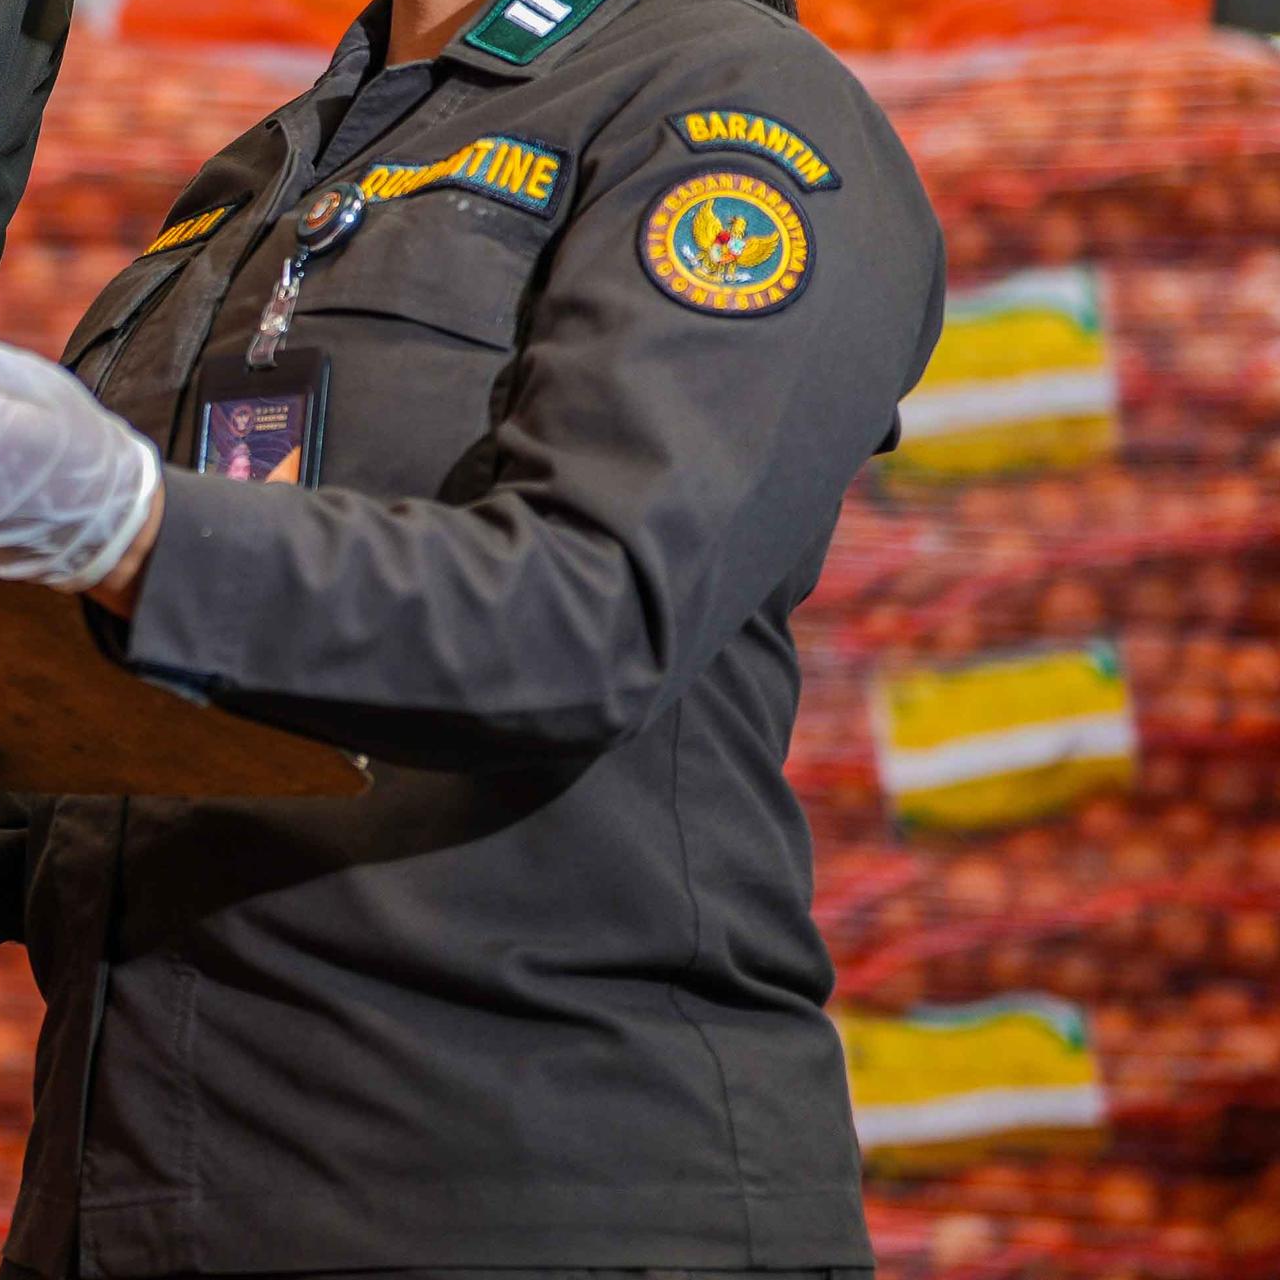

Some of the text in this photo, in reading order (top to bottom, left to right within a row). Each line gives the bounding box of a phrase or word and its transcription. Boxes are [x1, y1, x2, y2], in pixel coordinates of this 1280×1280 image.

[360, 138, 559, 199] QUTINE
[685, 111, 830, 185] BARANTIN
[664, 174, 734, 210] BADAN
[647, 233, 785, 311] INDONESIA
